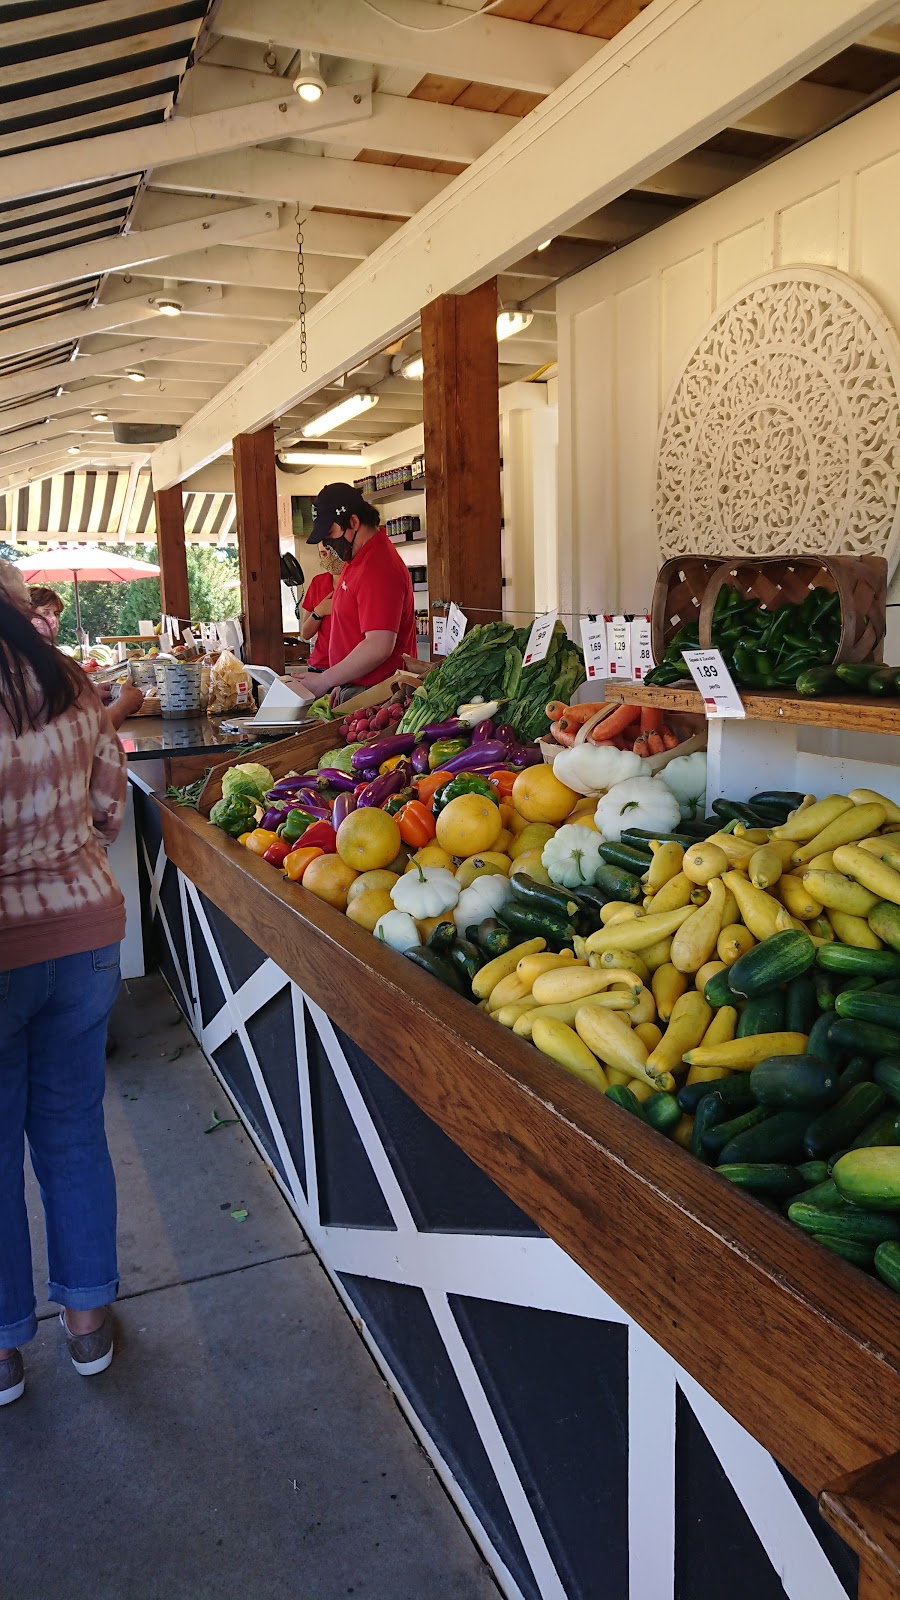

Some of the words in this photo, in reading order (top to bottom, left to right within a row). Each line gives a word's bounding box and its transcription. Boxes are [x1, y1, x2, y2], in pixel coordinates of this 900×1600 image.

[590, 642, 602, 652] 1.69
[614, 642, 626, 650] 1.29
[640, 650, 650, 659] .88
[696, 665, 718, 677] 1.89
